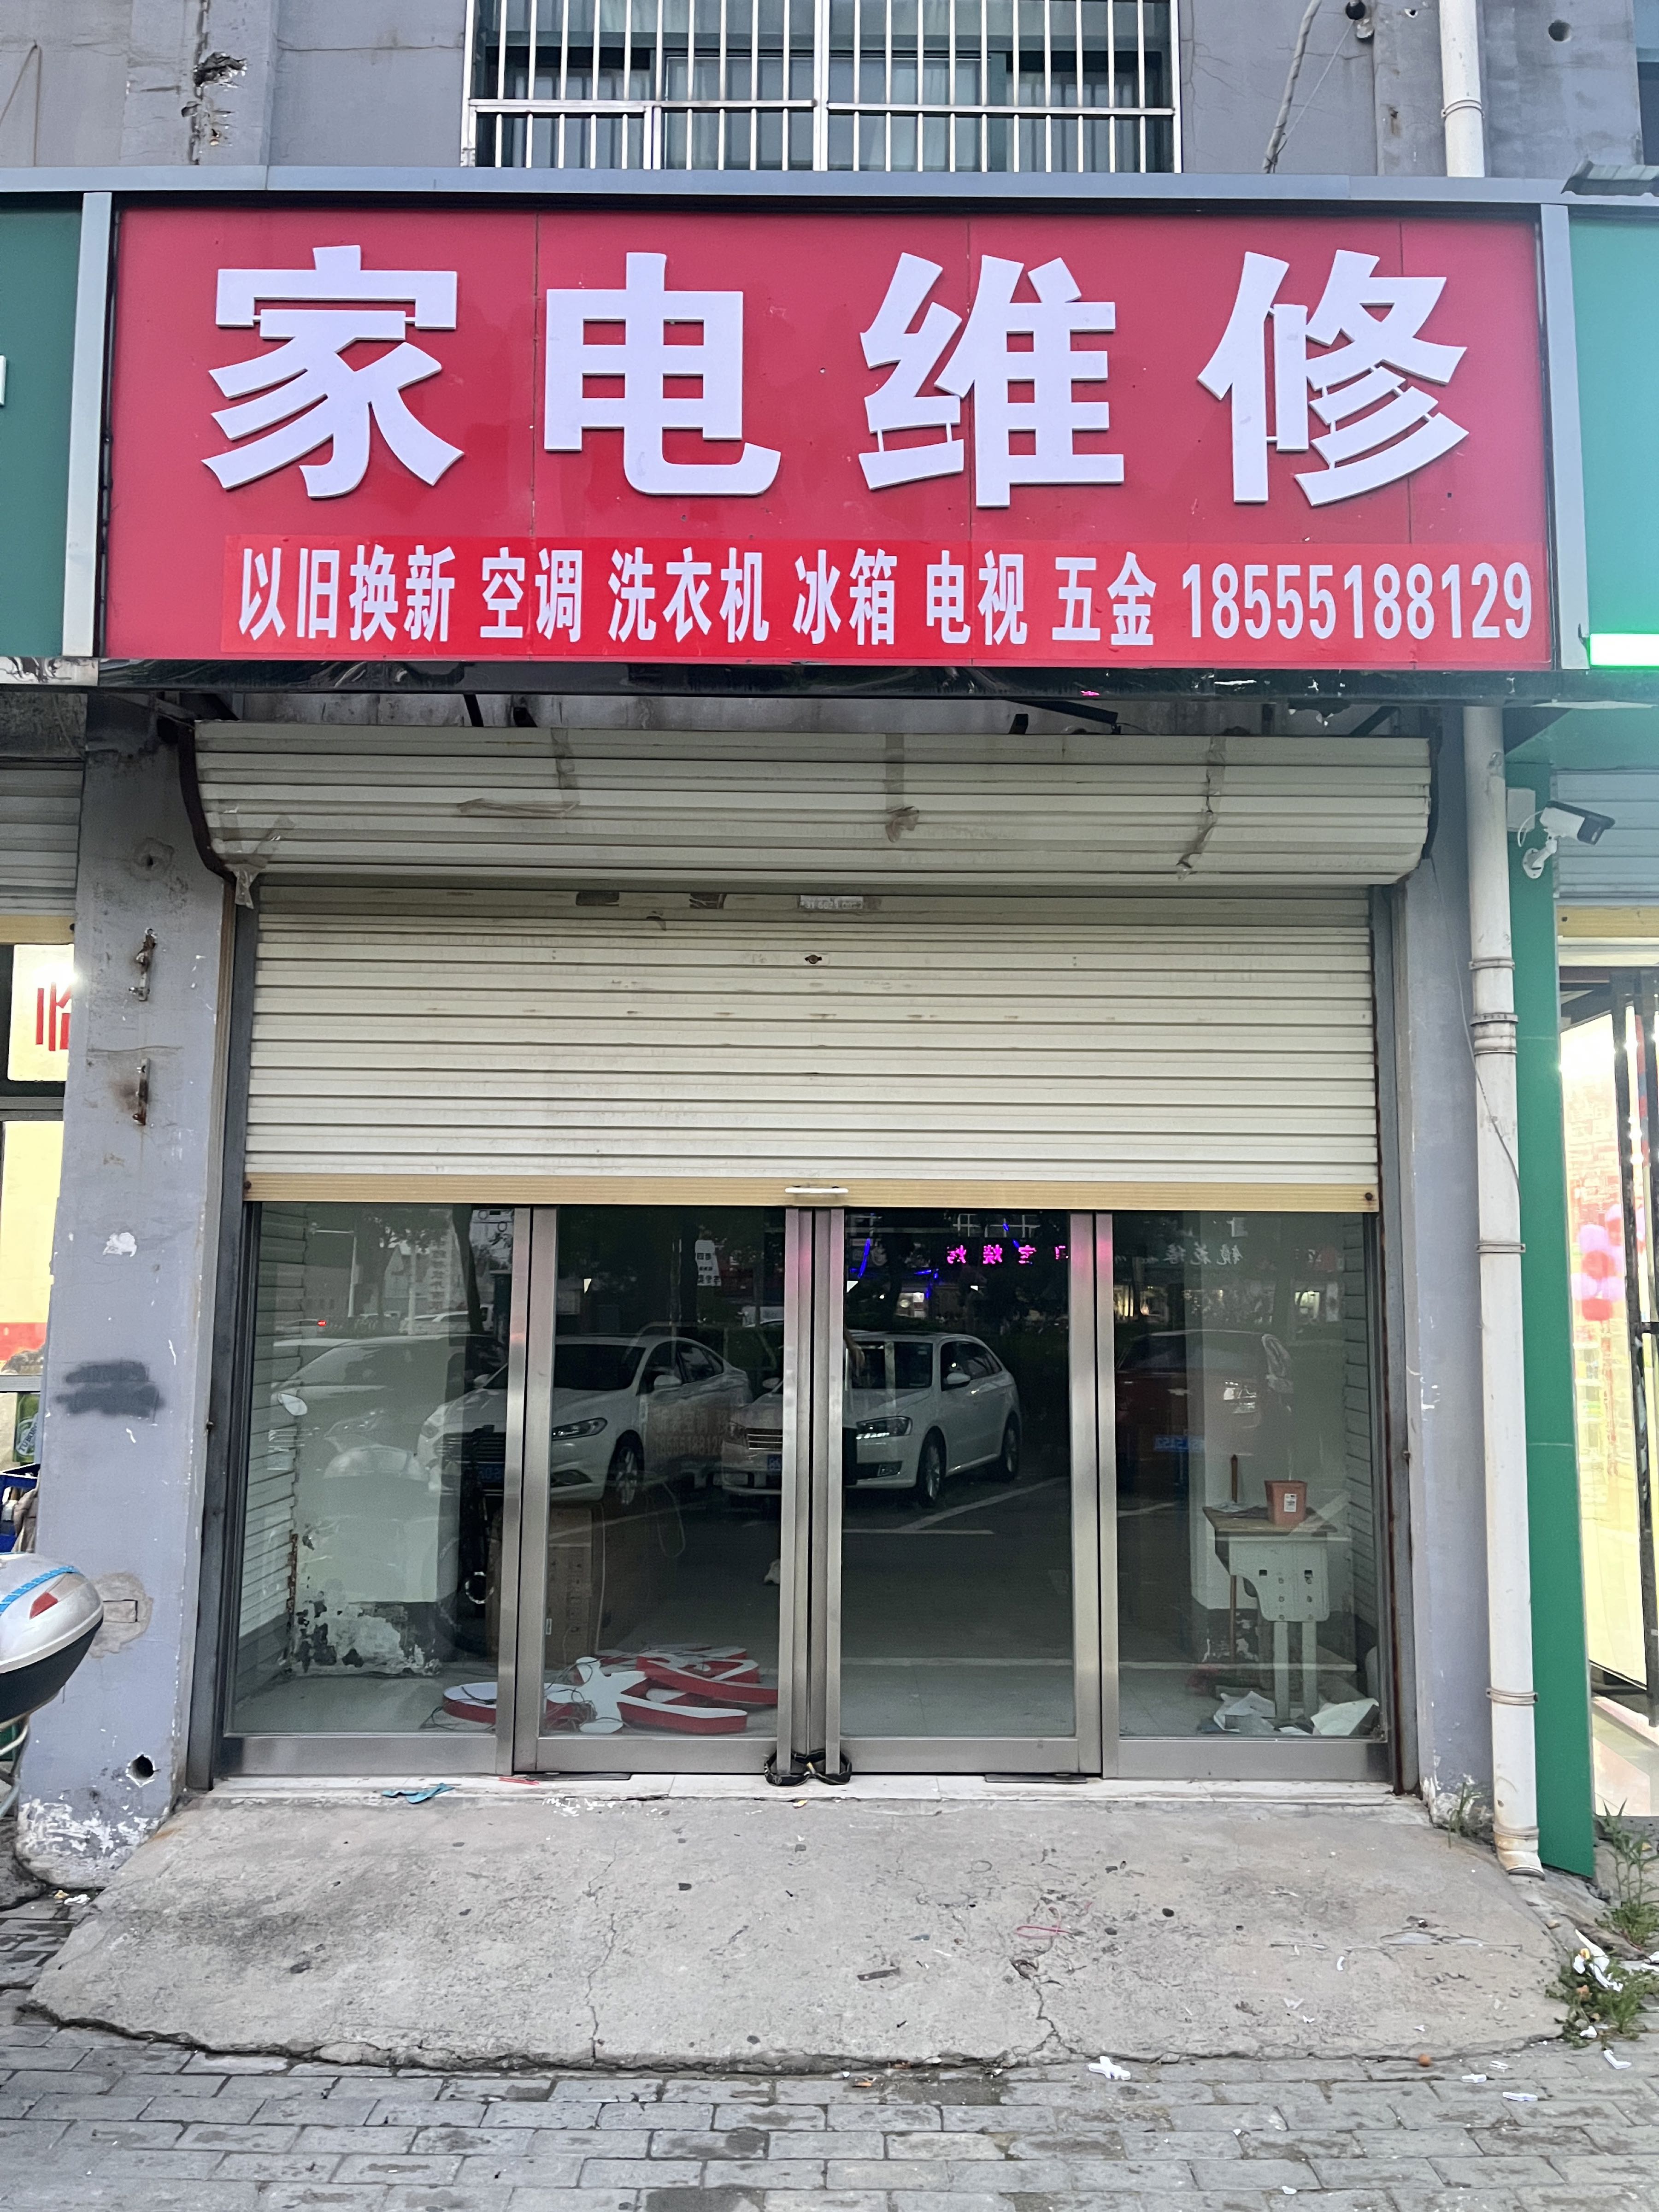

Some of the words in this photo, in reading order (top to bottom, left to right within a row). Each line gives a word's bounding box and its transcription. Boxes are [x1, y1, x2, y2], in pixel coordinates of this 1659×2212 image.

[201, 245, 1469, 506] 家电维修
[239, 544, 455, 641] 以旧换新
[481, 547, 582, 642] 空调
[608, 547, 769, 642] 洗衣机
[793, 548, 897, 645] 冰箱
[927, 550, 1027, 645] 电视
[1052, 552, 1156, 645] 五金
[1183, 562, 1531, 639] 18555188129
